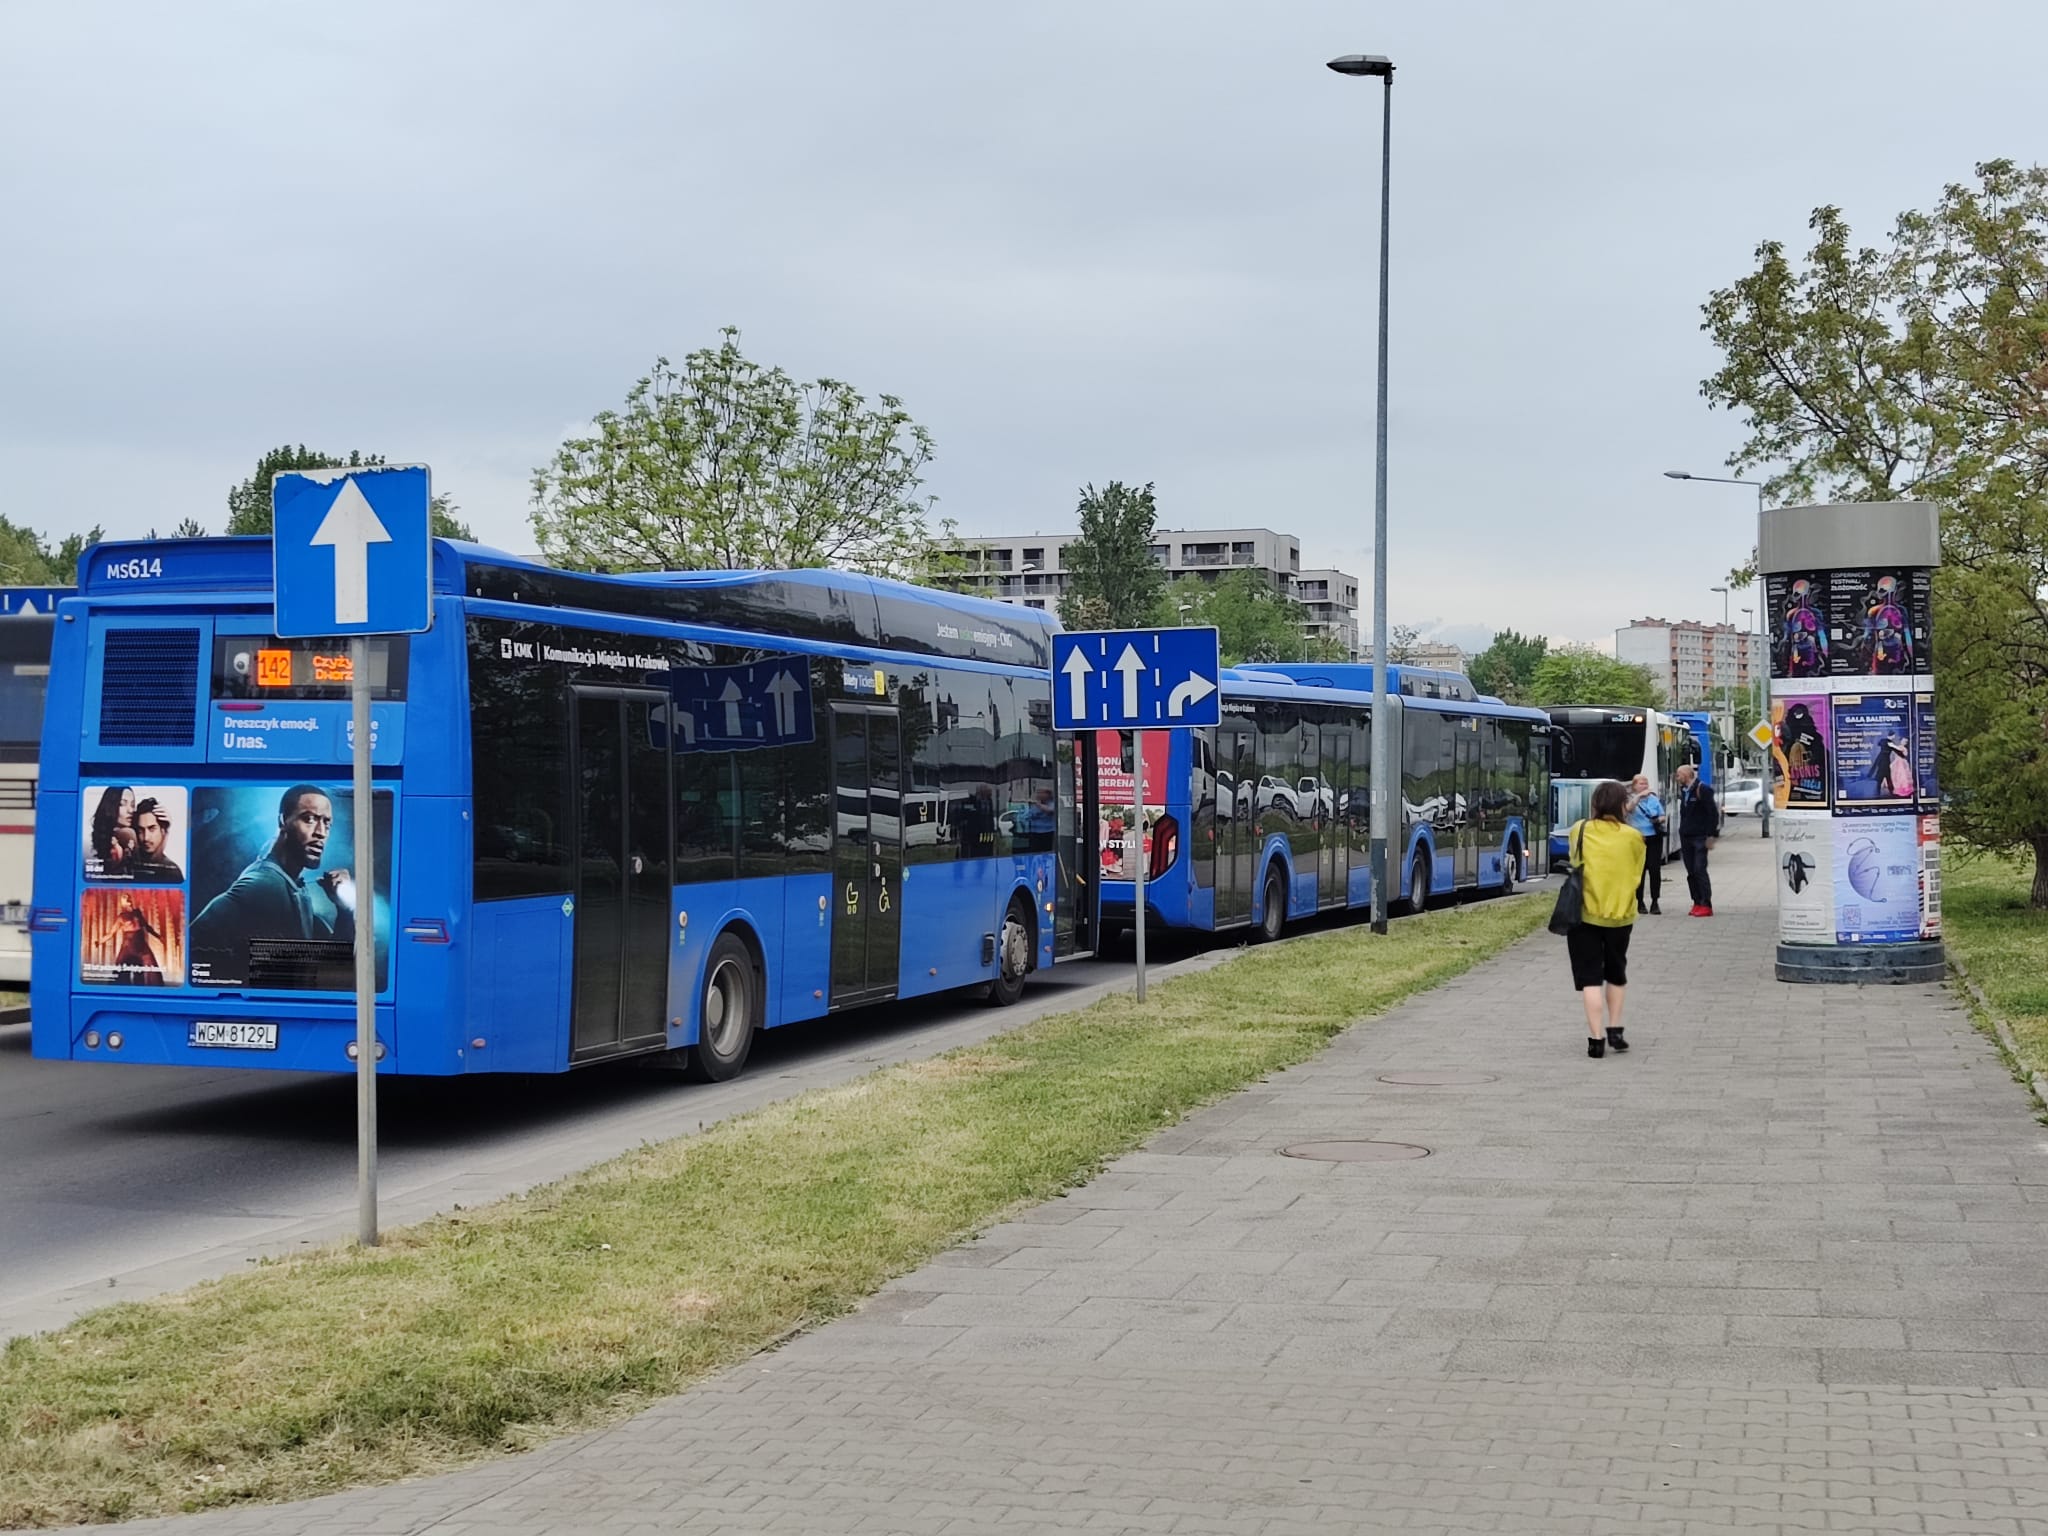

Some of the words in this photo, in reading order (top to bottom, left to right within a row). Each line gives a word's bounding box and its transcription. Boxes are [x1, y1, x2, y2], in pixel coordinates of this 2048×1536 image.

[106, 557, 162, 579] MS614
[312, 655, 354, 669] Czyży
[513, 642, 534, 658] KMK
[543, 645, 596, 667] Komunikacja
[596, 650, 627, 669] Miejska
[627, 656, 635, 667] w
[635, 654, 670, 671] Krakowie
[259, 656, 289, 679] 142
[315, 669, 354, 681] Dworz
[223, 716, 279, 731] Dreszczyk
[280, 717, 319, 732] emocji.
[223, 733, 235, 748] U
[236, 736, 267, 749] nas.
[1098, 778, 1149, 788] SERENAA
[198, 1024, 226, 1041] WGM
[230, 1025, 274, 1044] 8129L
